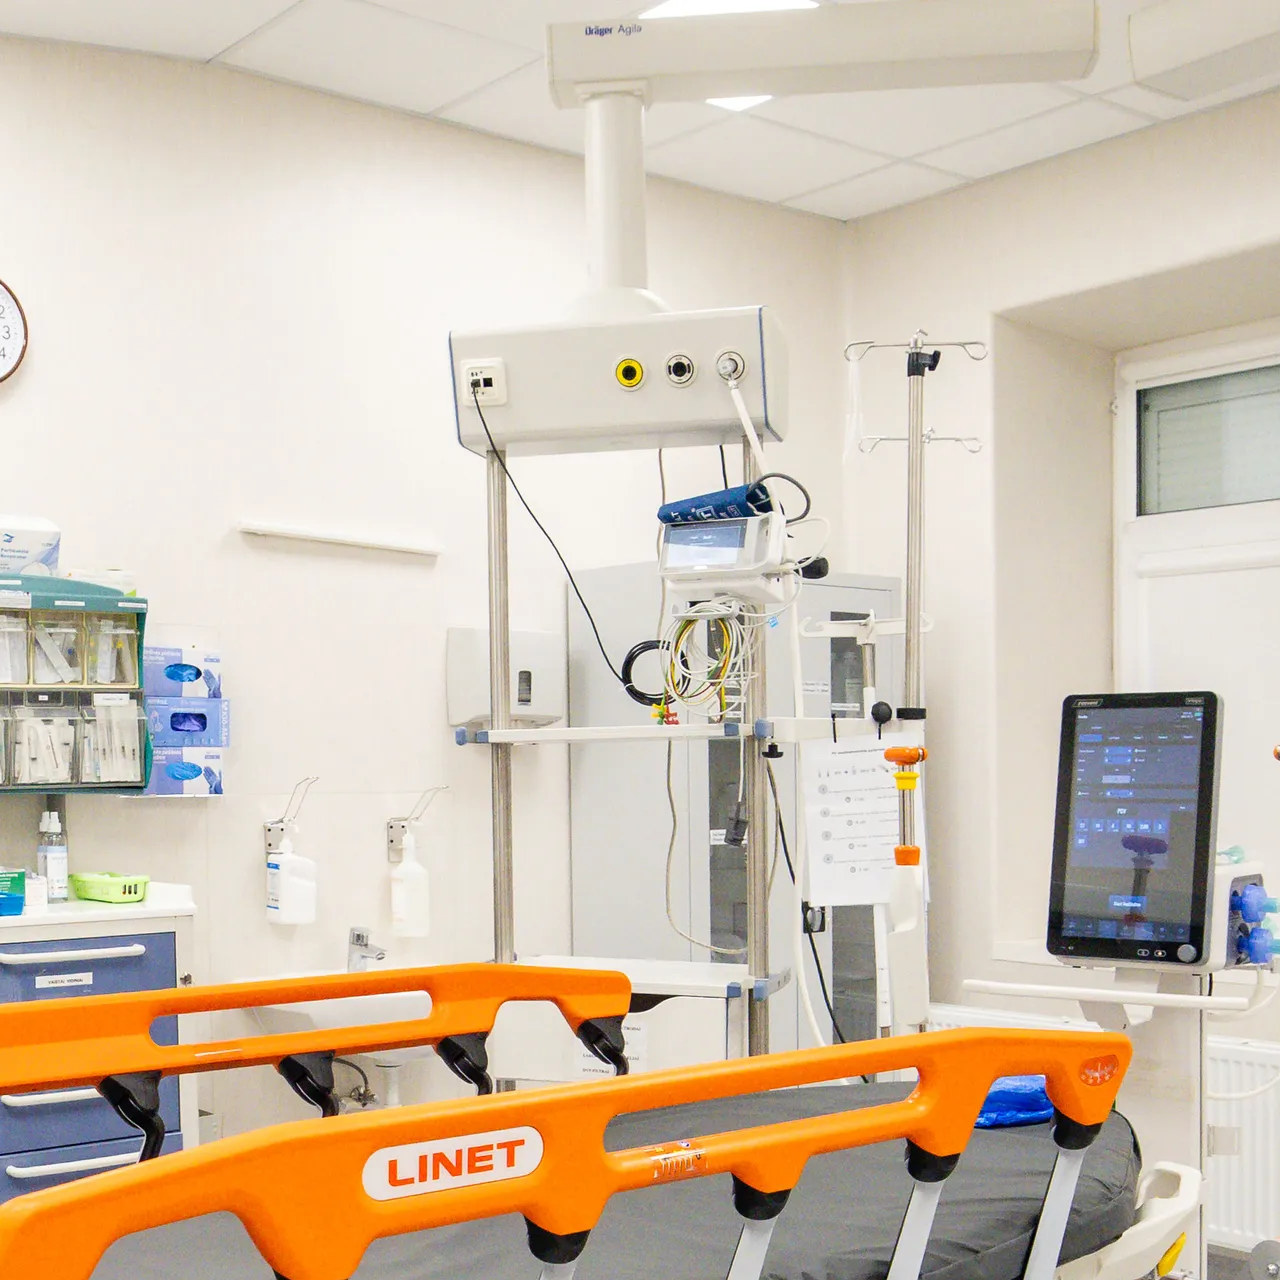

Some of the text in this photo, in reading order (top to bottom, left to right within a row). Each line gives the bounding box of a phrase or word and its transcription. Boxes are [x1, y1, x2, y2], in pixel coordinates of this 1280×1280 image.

[585, 24, 642, 36] Dräger Agila
[2, 326, 11, 340] 3
[388, 1139, 525, 1187] LINET
